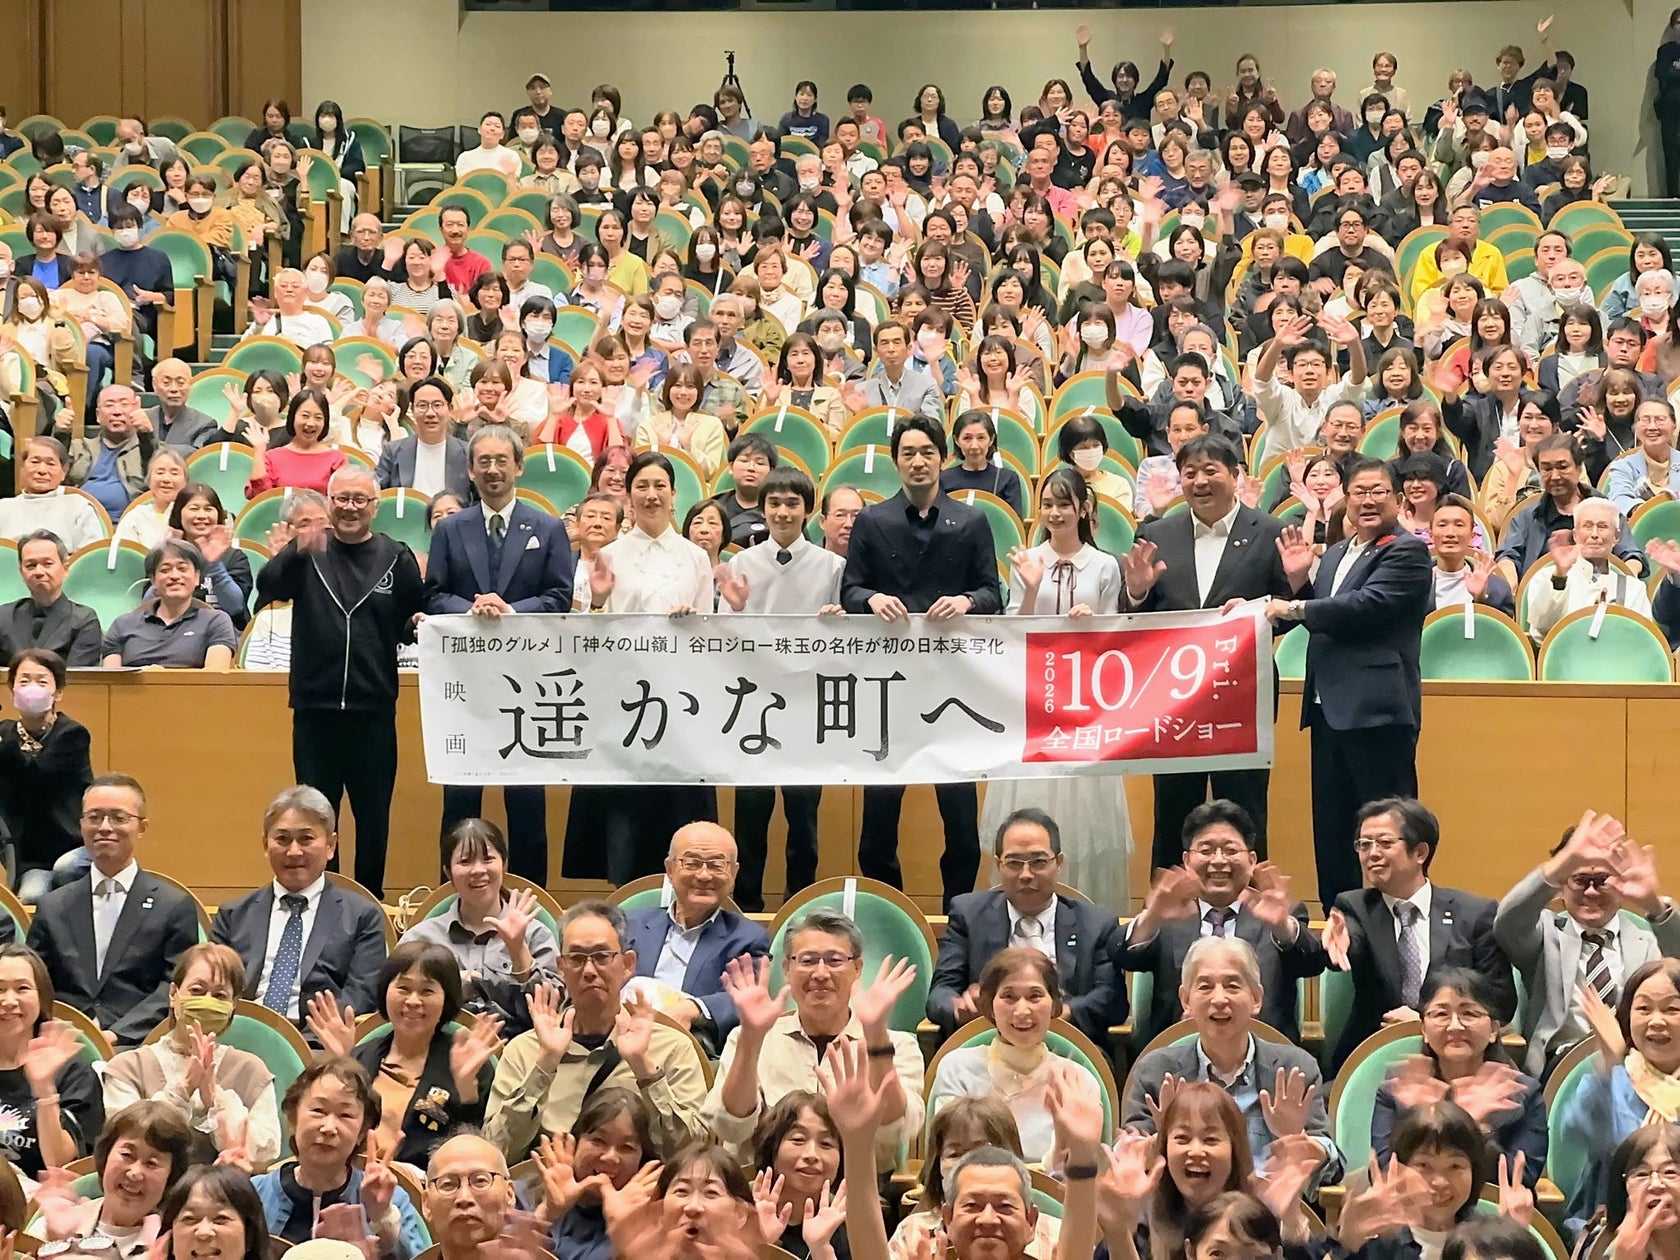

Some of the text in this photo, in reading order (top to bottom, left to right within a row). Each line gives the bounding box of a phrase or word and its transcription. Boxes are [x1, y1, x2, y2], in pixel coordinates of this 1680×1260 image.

[1044, 651, 1056, 714] 2026
[1061, 644, 1207, 712] 10/9
[1212, 635, 1239, 700] Fri.
[444, 680, 468, 756] 映画
[498, 668, 1006, 762] 遥かな町へ
[1041, 715, 1243, 751] 全国ロードショー
